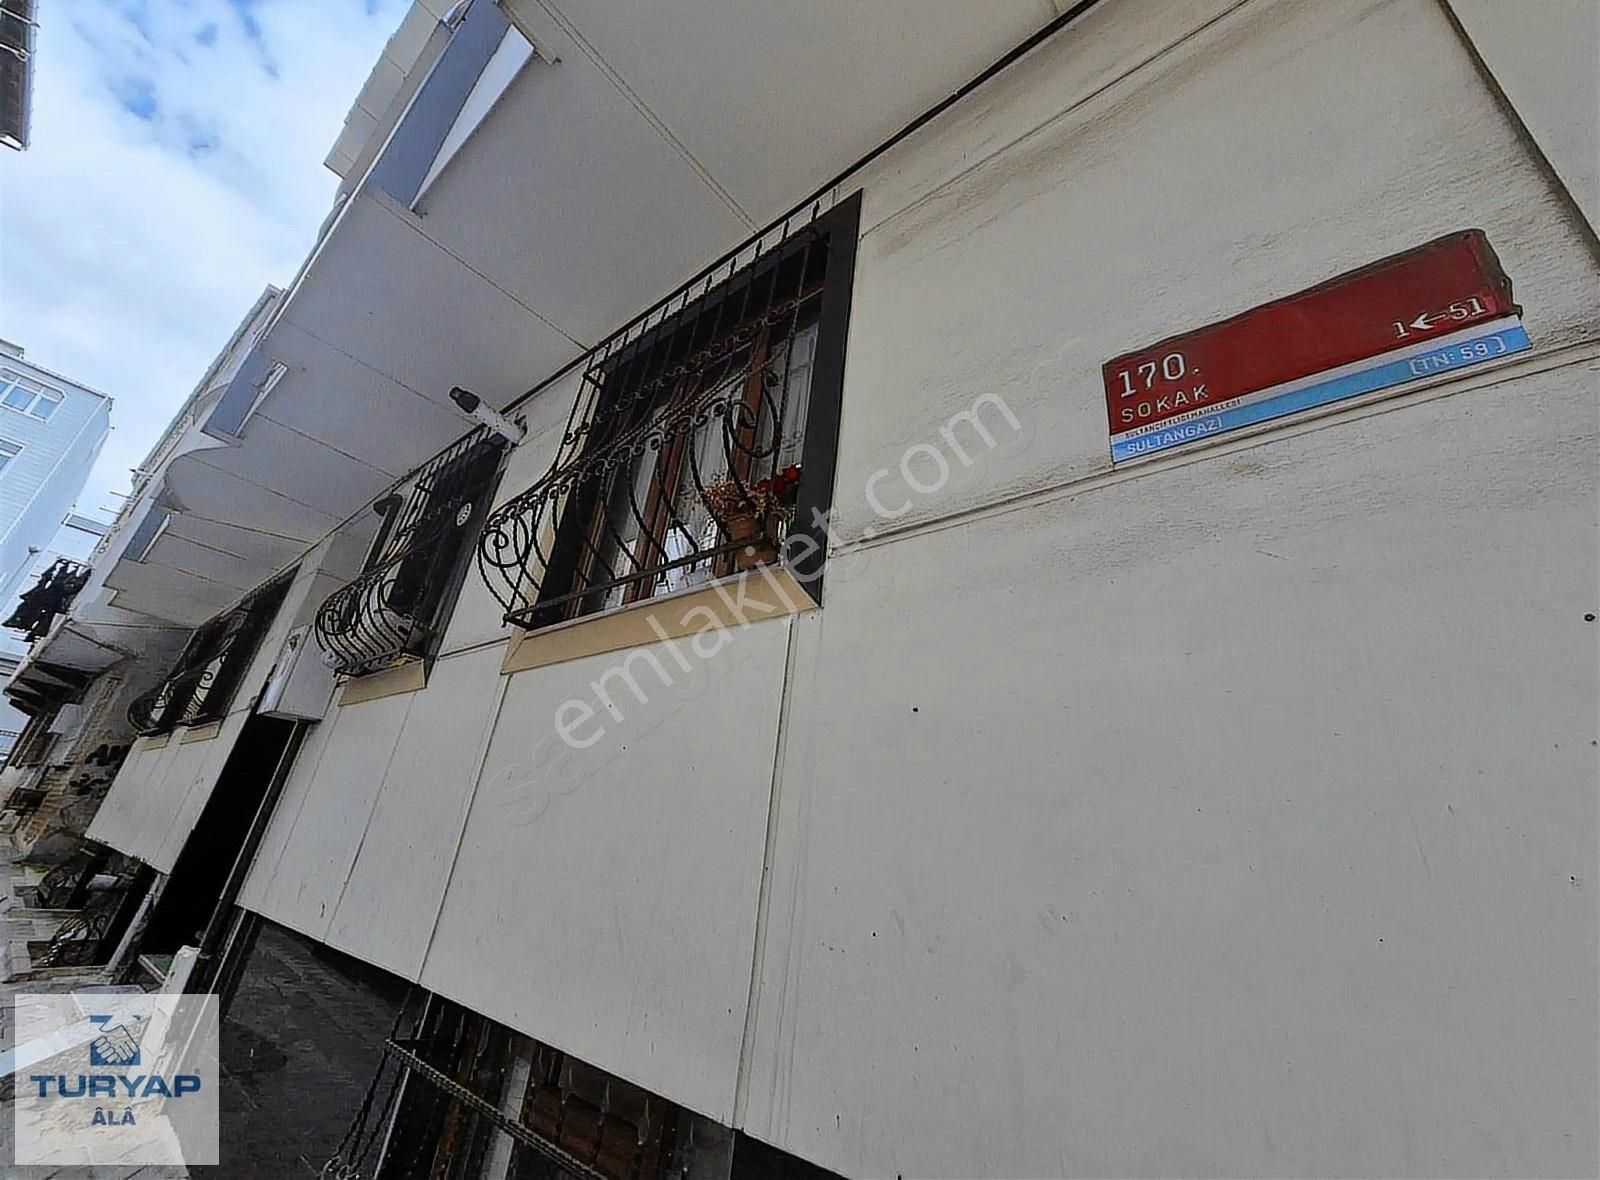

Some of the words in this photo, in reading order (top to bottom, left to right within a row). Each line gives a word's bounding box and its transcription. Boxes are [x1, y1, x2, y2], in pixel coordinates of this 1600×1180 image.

[1392, 322, 1410, 339] 1
[1449, 298, 1486, 321] 51
[1118, 353, 1200, 398] 170.
[1121, 384, 1209, 423] SOKAK
